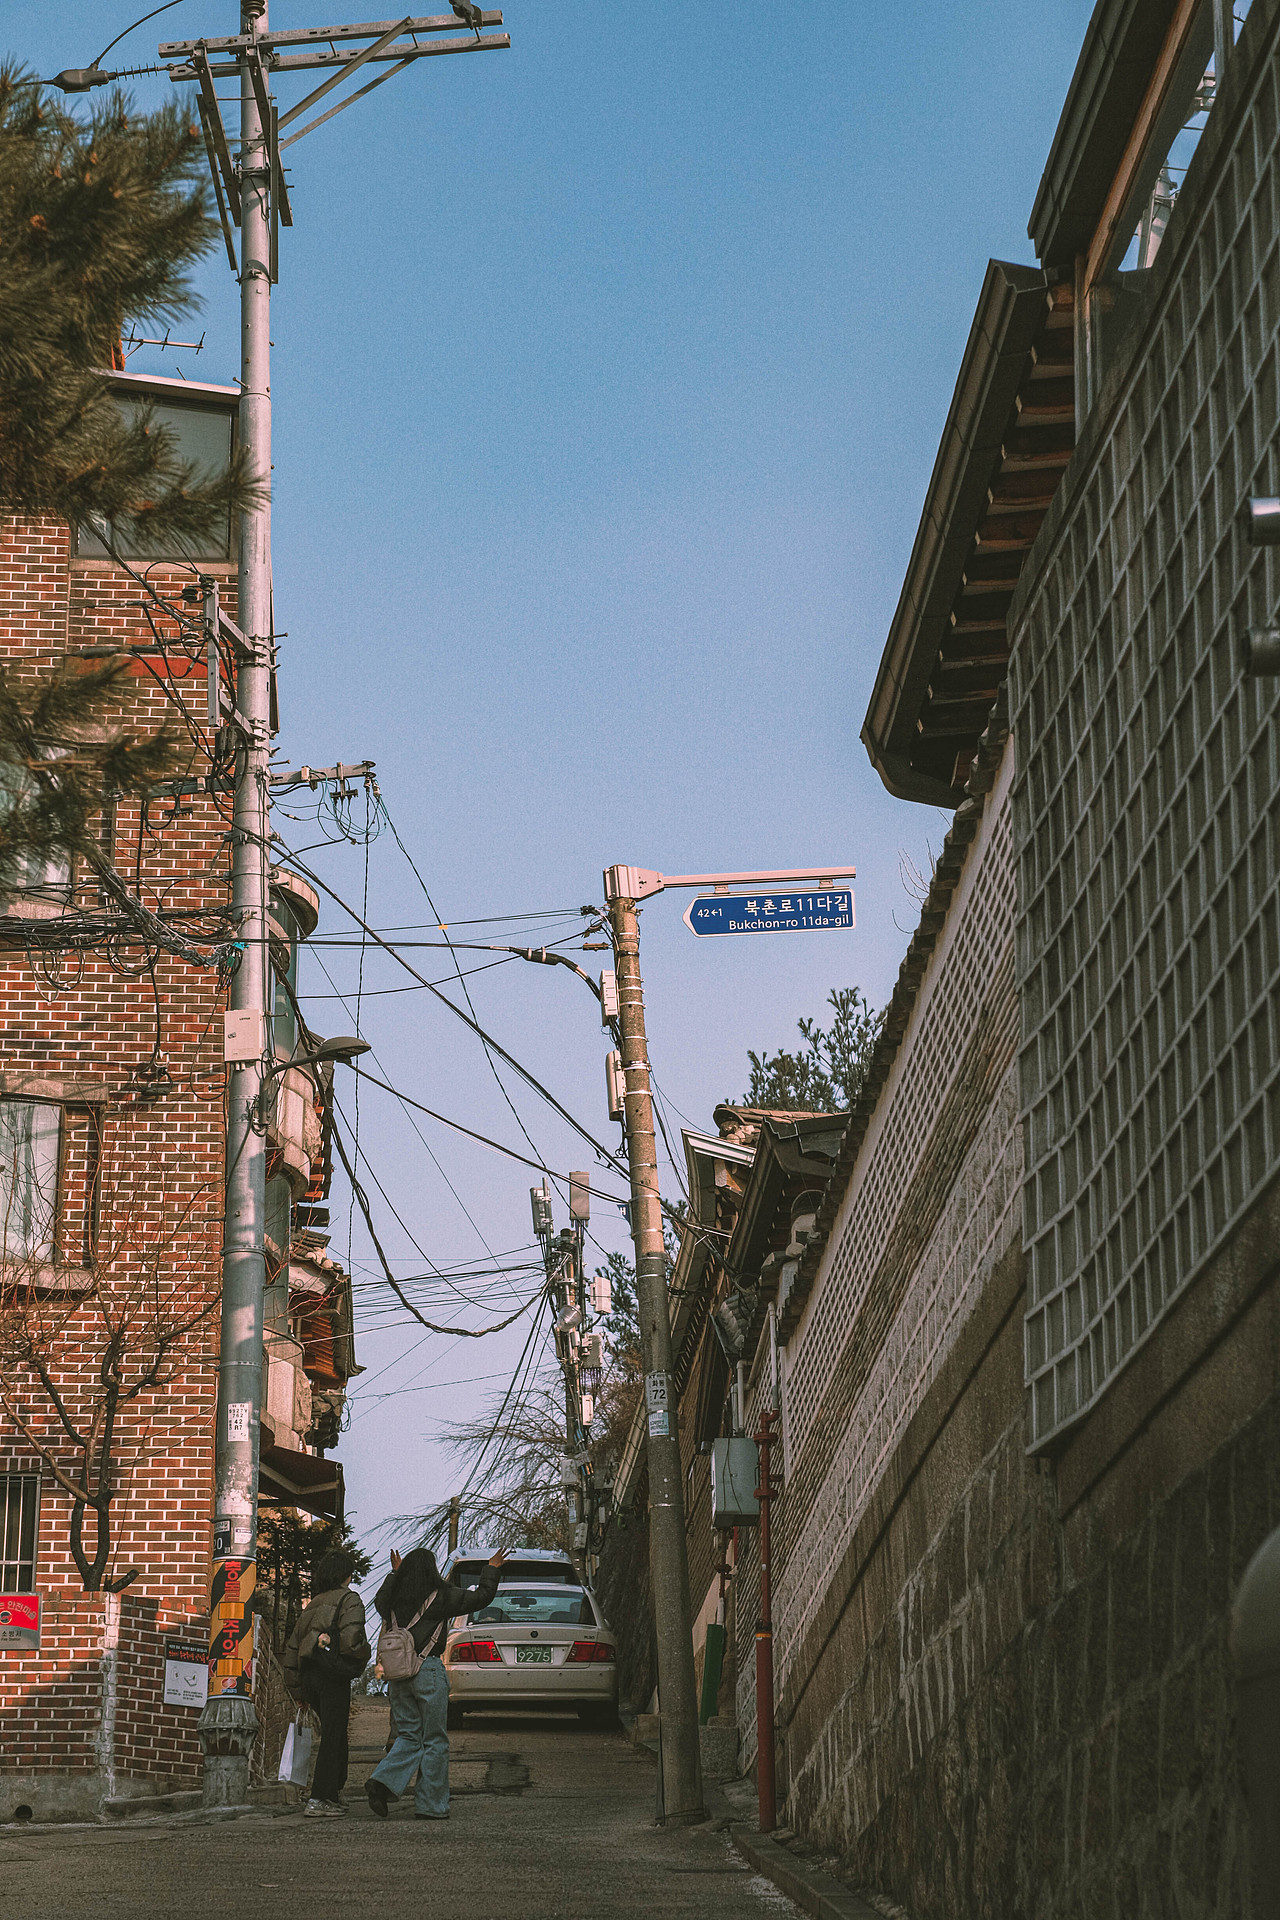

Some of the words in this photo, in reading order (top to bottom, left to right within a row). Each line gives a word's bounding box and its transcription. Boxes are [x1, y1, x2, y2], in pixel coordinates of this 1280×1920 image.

[744, 894, 849, 916] 북촌로11다길
[729, 918, 799, 930] Bukchon-ro
[801, 914, 849, 927] 11da-gil
[652, 1389, 666, 1400] 72
[517, 1651, 551, 1663] 9275
